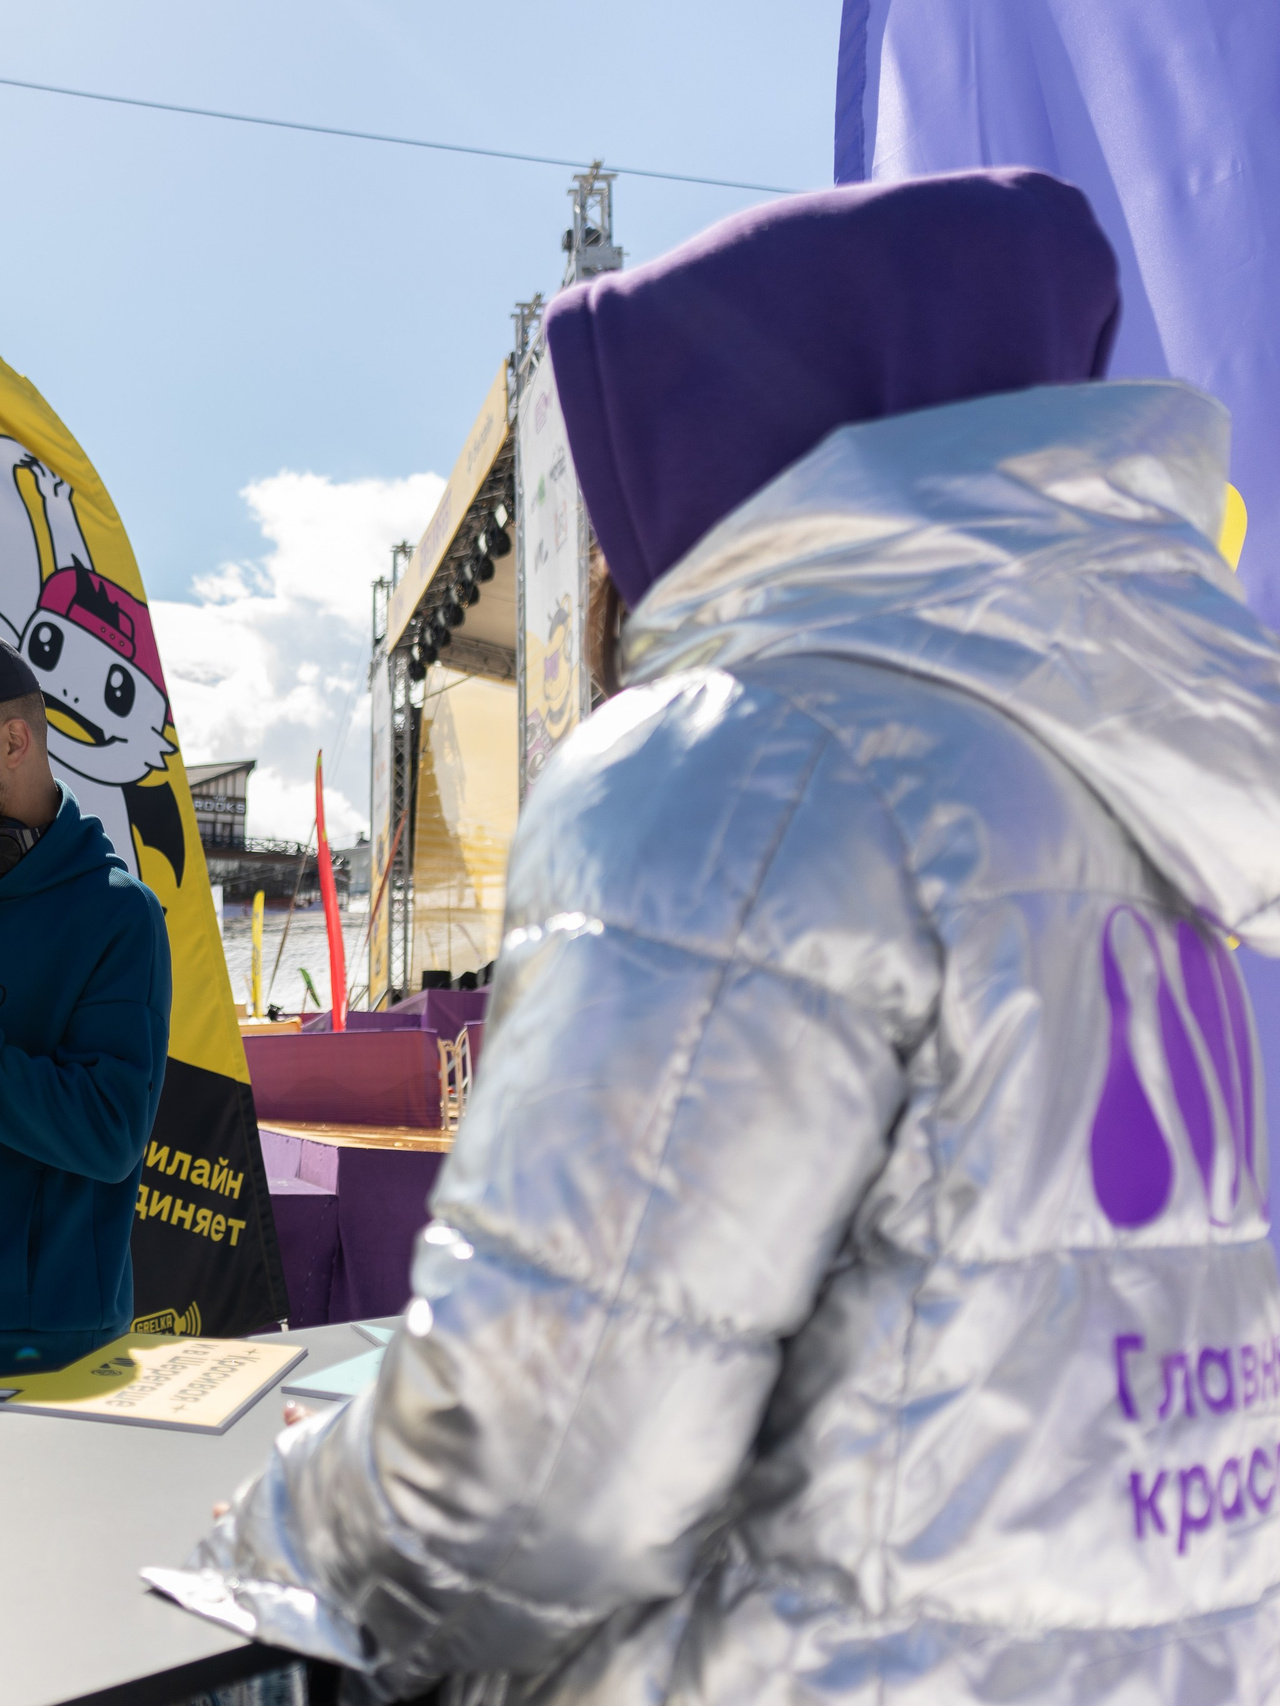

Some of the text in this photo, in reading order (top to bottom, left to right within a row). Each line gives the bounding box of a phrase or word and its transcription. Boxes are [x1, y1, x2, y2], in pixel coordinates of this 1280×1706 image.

[143, 1141, 244, 1200] илайн
[1114, 1333, 1280, 1422] Главн
[1129, 1445, 1280, 1557] крас
